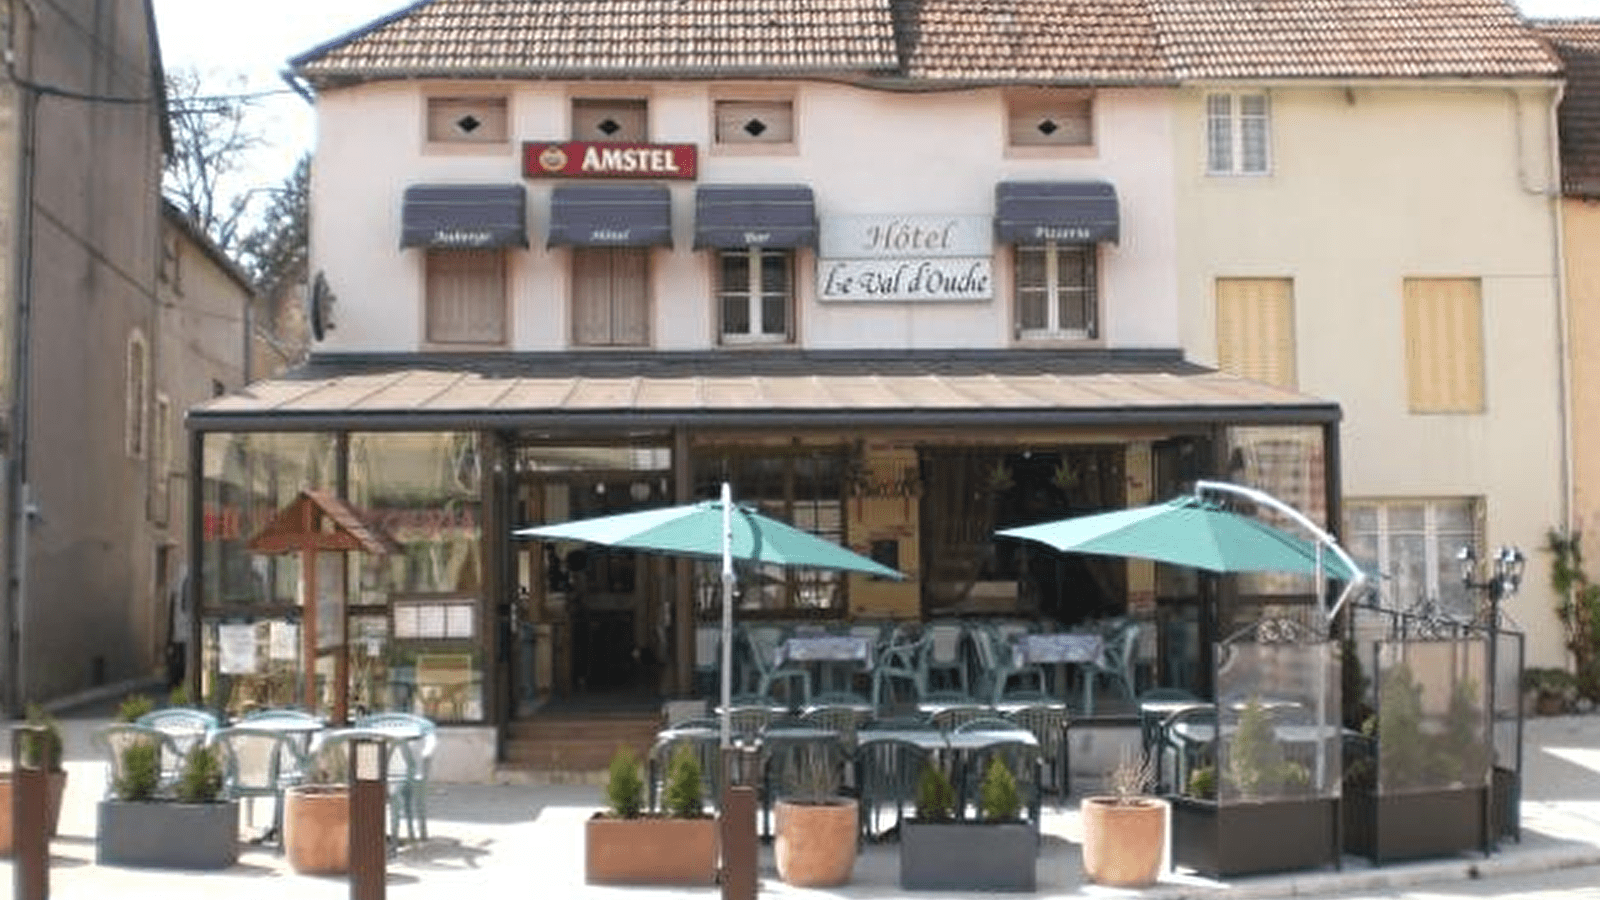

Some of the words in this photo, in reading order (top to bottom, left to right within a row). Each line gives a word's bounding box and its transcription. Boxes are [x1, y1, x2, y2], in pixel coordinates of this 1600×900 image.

[581, 146, 681, 172] AMSTEL
[863, 218, 956, 250] Hôtel
[824, 262, 853, 295] Le
[858, 262, 908, 294] Val
[908, 261, 988, 294] d'Ouche
